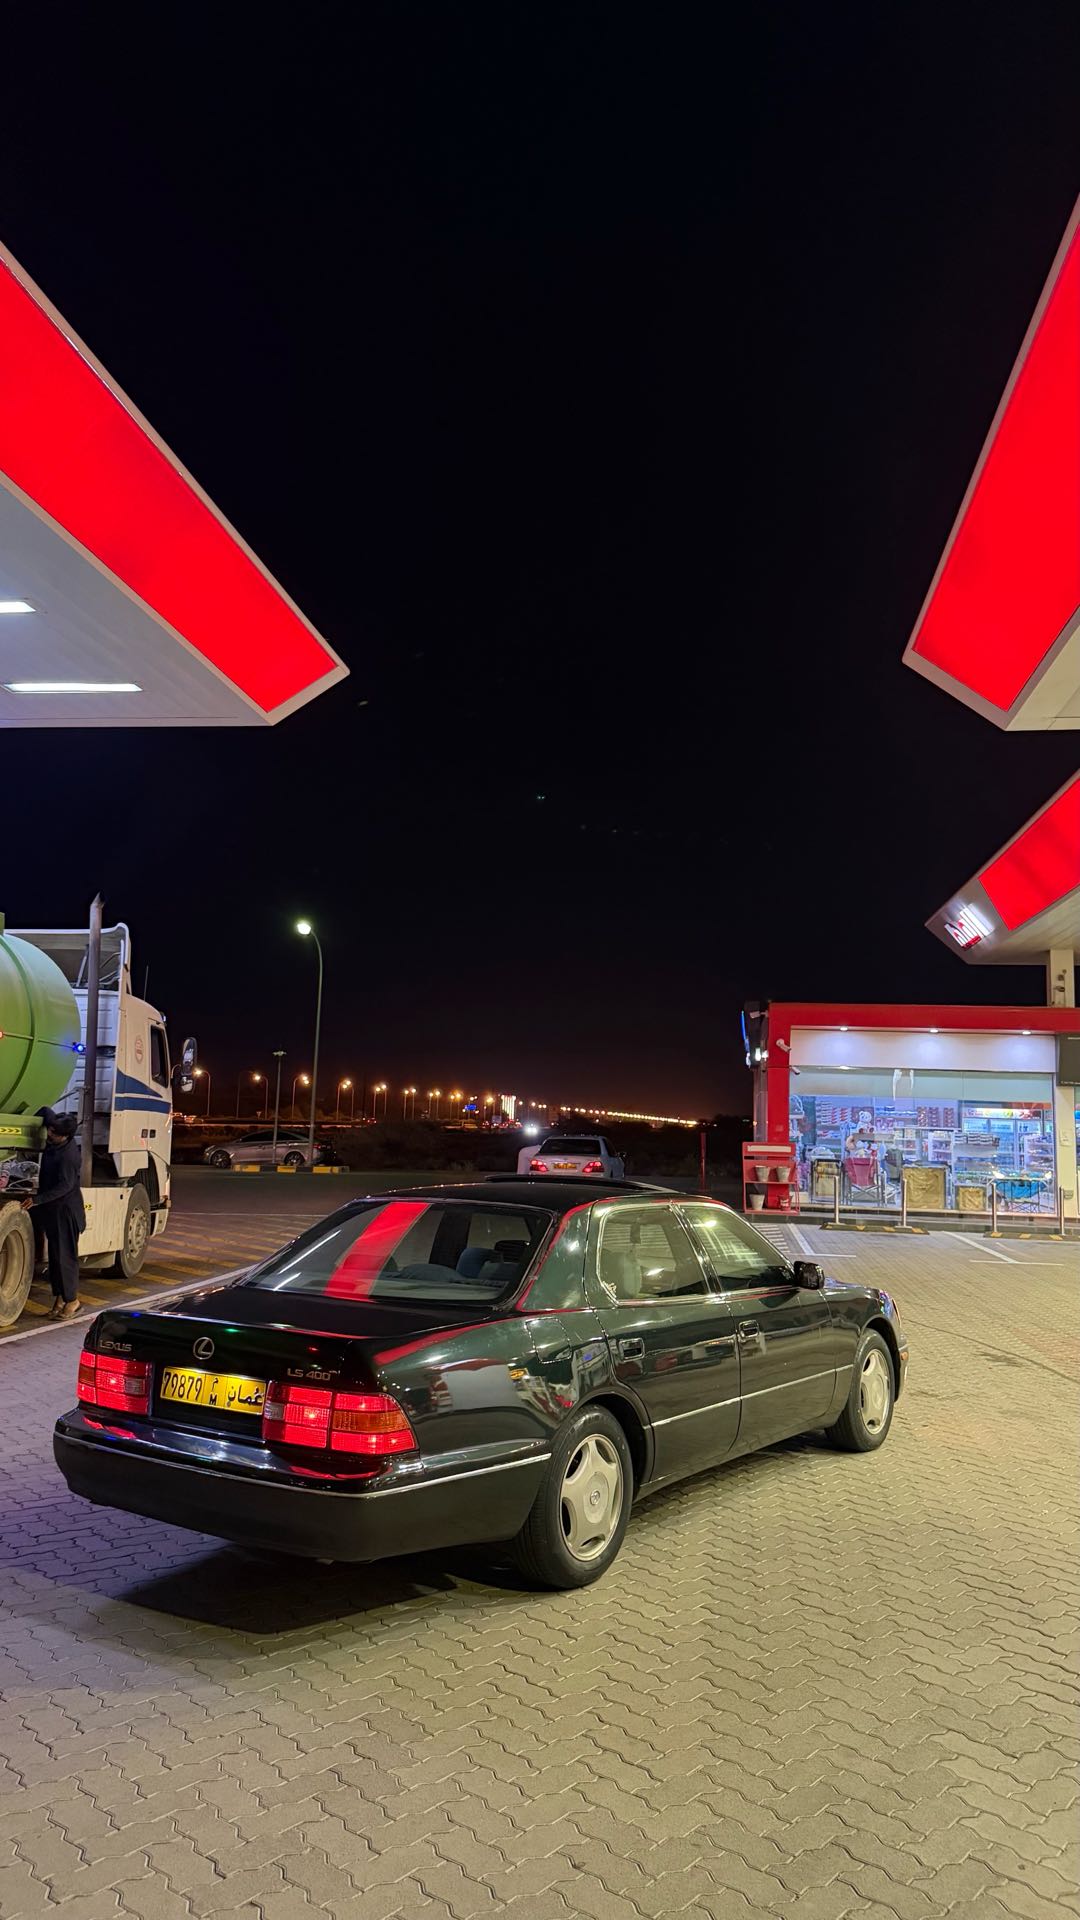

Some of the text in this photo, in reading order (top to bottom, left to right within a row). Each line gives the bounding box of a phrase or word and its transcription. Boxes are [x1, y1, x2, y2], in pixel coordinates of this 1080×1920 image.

[99, 1339, 133, 1352] LEXUS
[287, 1367, 331, 1381] LS 400
[163, 1371, 203, 1402] 79879
[209, 1393, 218, 1406] M
